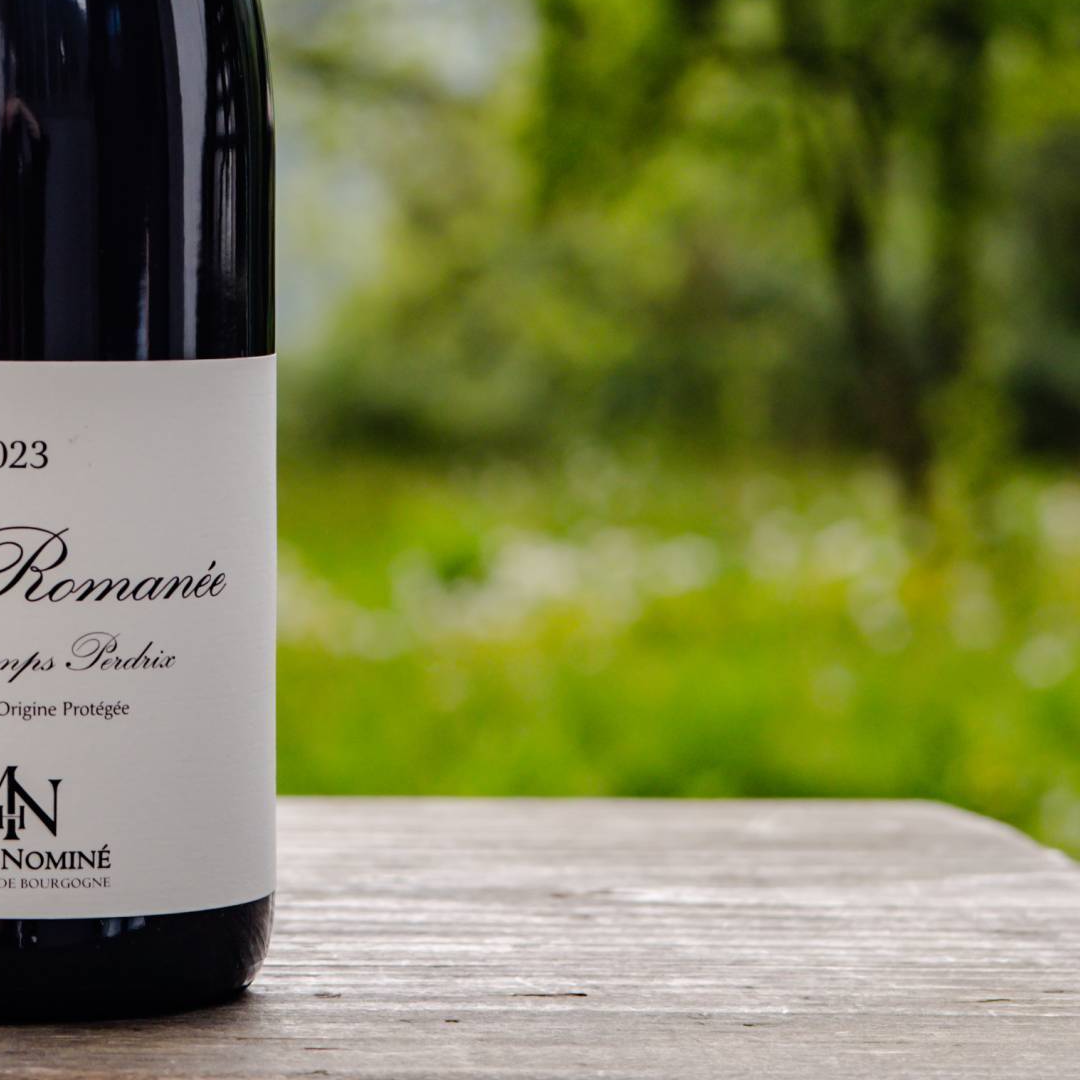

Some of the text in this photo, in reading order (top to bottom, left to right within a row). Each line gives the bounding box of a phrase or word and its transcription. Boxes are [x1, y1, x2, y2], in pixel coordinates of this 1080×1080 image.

[64, 631, 177, 672] Perdrix
[62, 700, 131, 721] Protégée
[20, 876, 111, 890] BOURGOGNE
